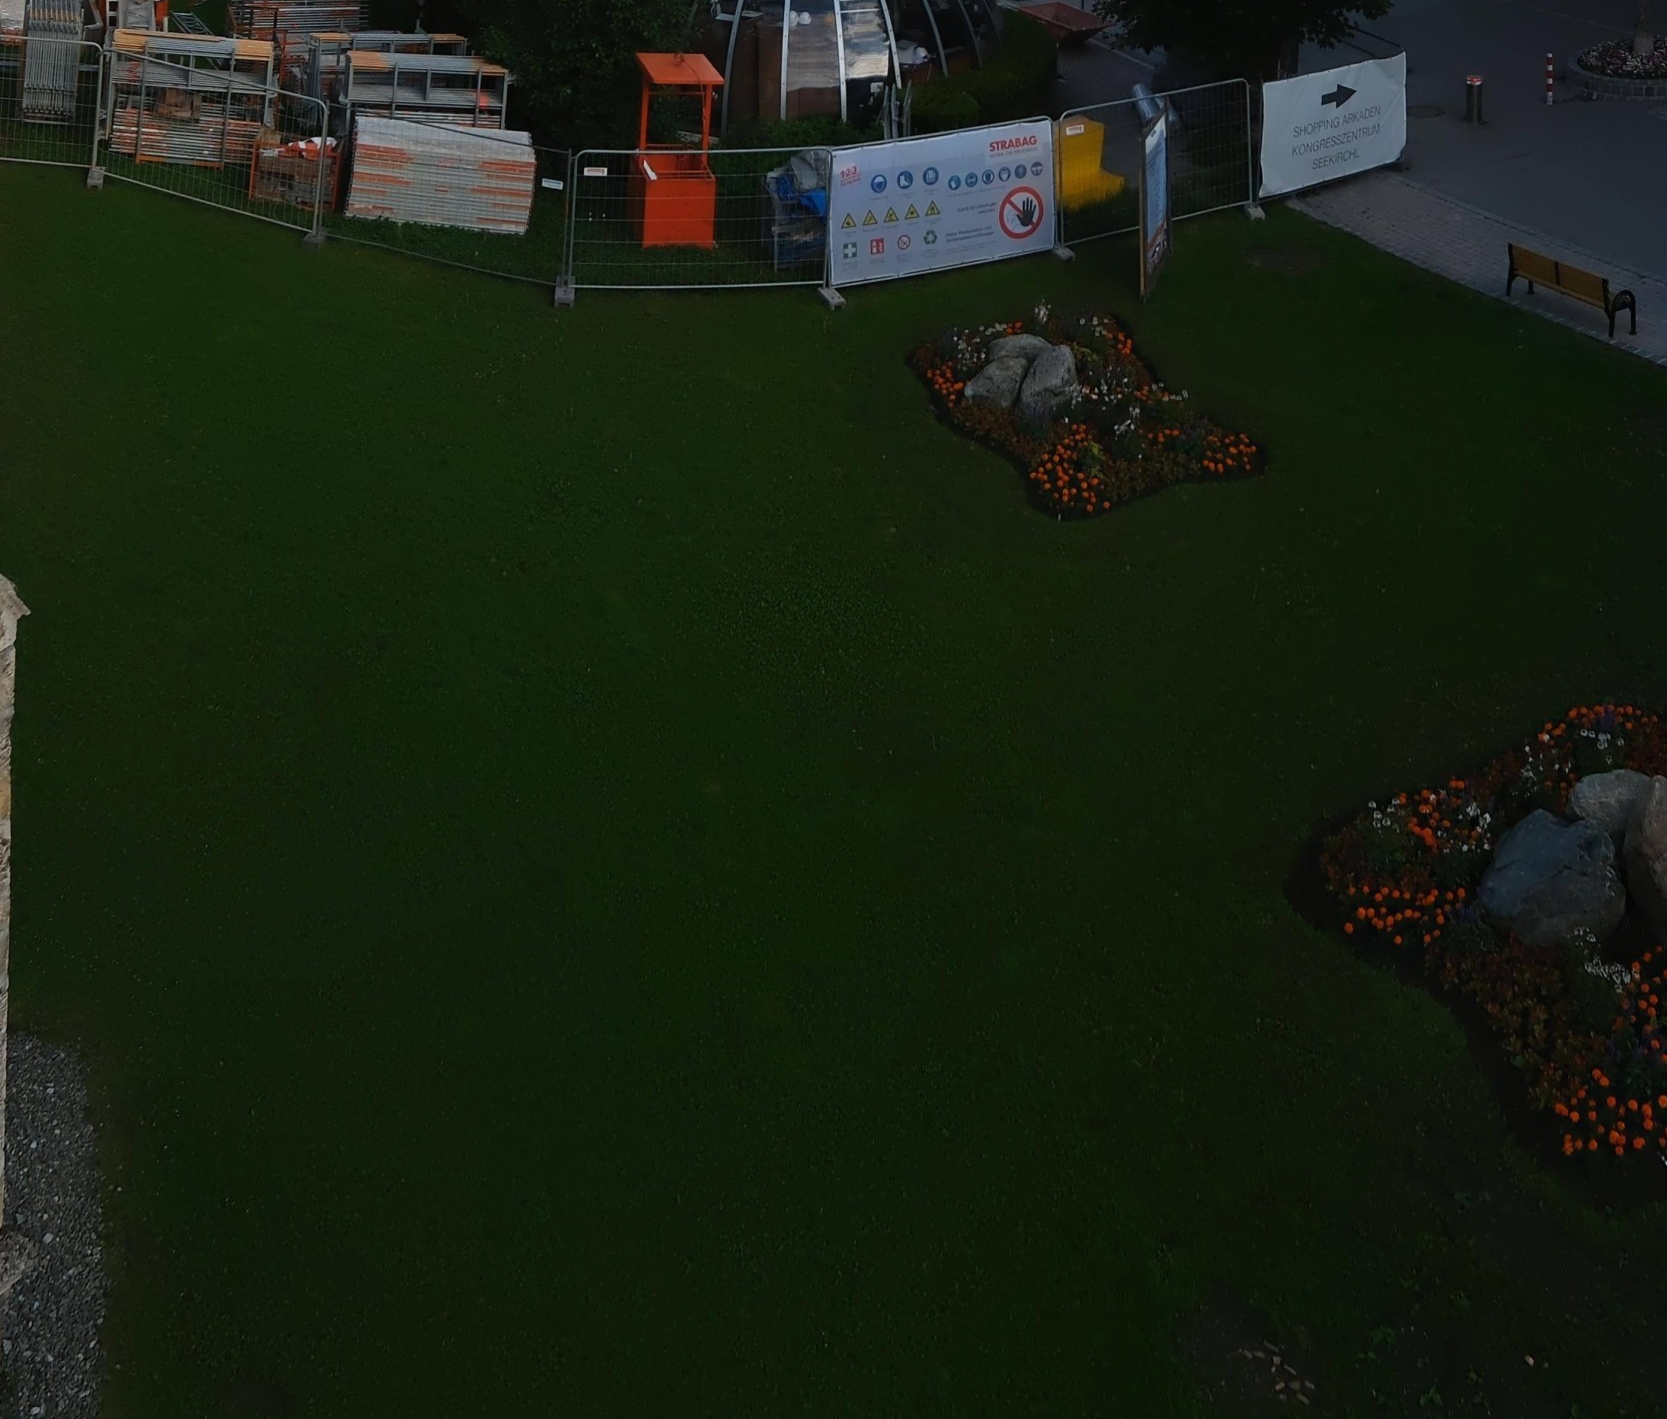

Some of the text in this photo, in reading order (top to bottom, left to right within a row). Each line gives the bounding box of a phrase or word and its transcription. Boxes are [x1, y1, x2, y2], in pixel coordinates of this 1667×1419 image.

[1294, 106, 1382, 138] SHOPPING ARKADEN
[990, 136, 1038, 152] STRABAG
[1292, 123, 1380, 156] KONGRESSZENTRUM
[1312, 149, 1360, 170] SEEKIRCHL
